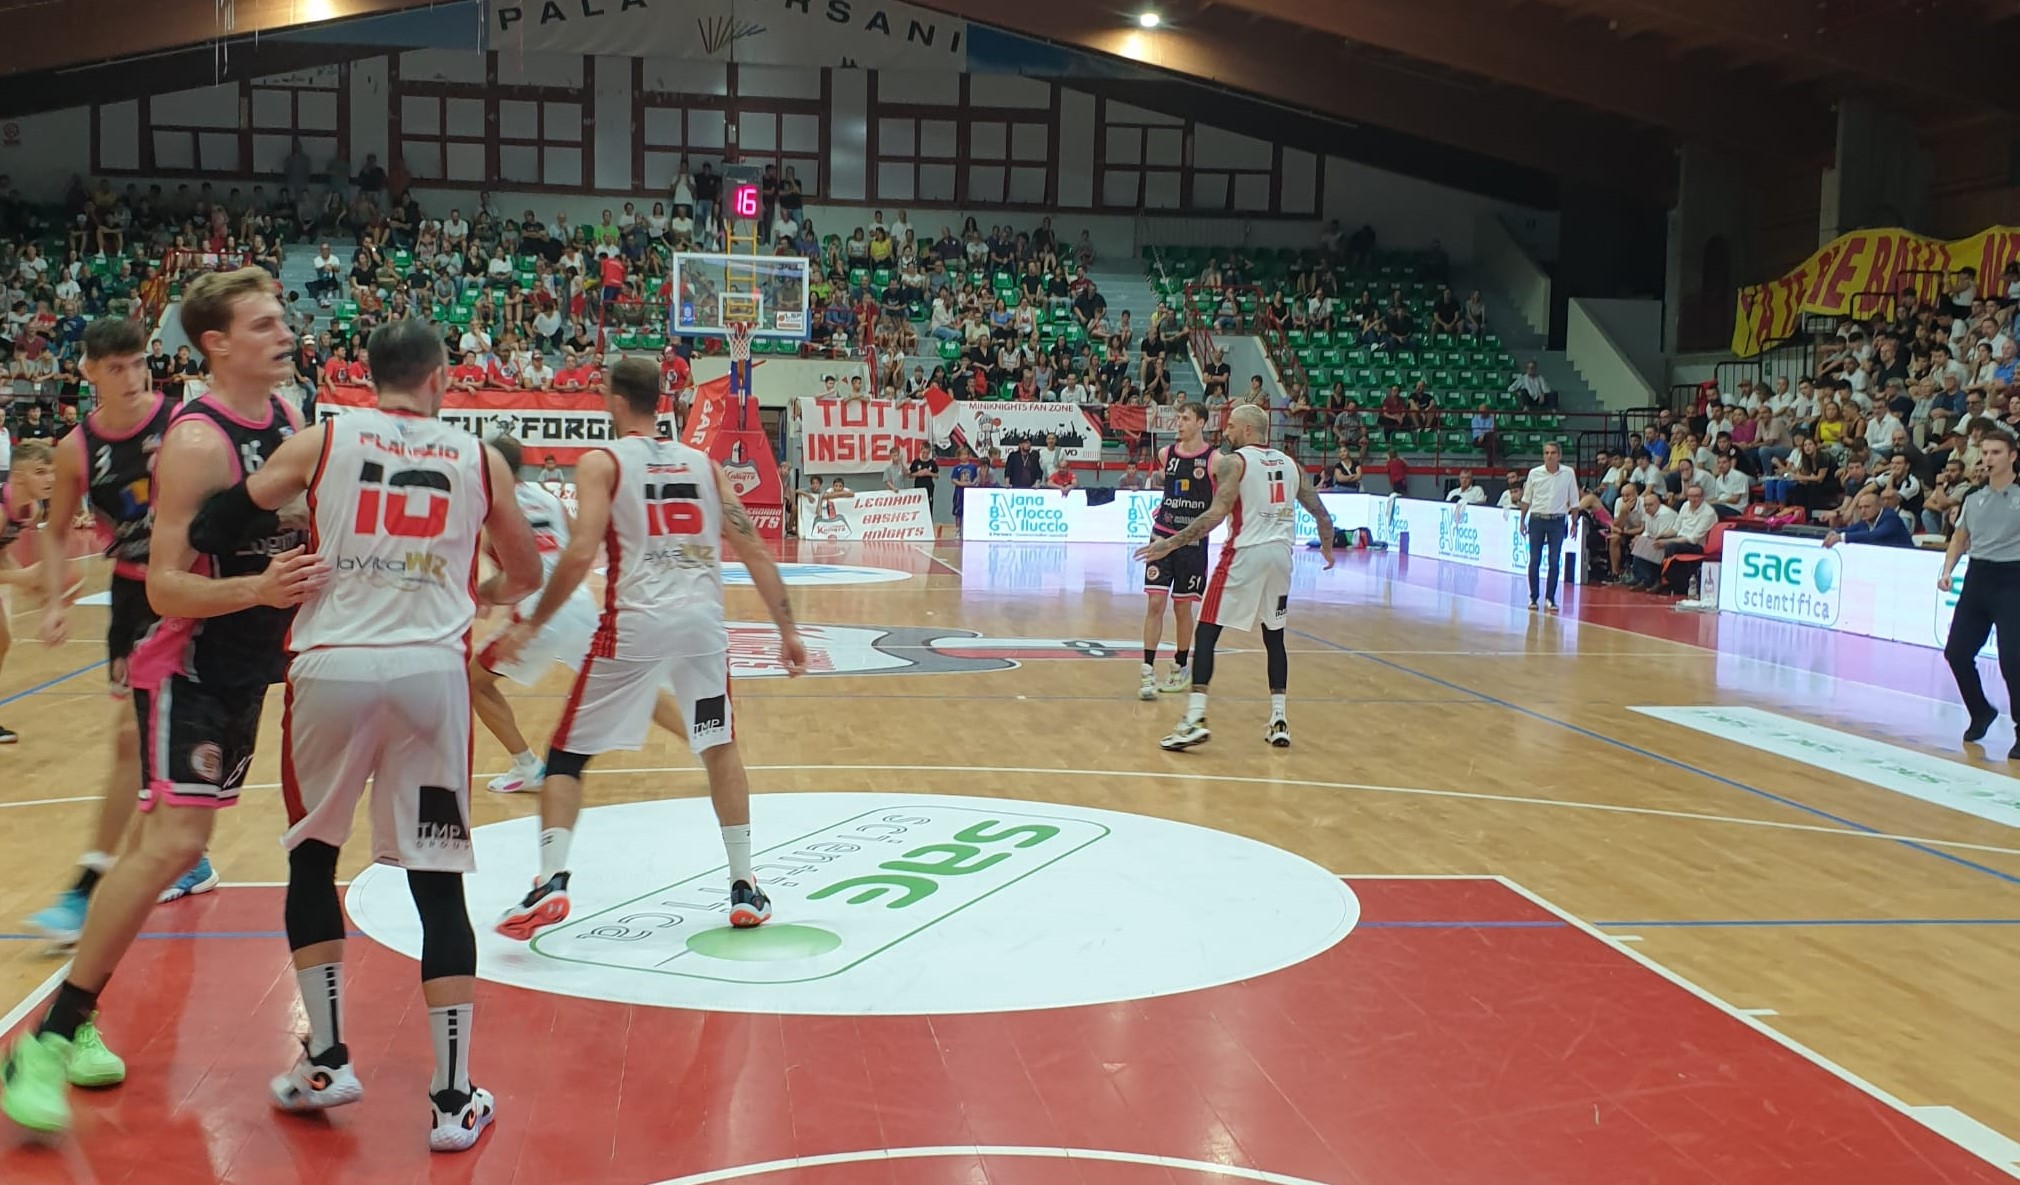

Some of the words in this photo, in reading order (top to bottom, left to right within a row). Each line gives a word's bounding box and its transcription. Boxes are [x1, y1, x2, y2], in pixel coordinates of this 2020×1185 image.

[736, 188, 757, 216] 16
[969, 402, 1027, 411] MINIKNIGHTS
[1030, 403, 1046, 411] FAN
[1049, 404, 1073, 412] ZONE
[1167, 458, 1180, 472] 51
[355, 459, 451, 538] 10
[645, 483, 704, 536] 16
[1187, 575, 1202, 590] 51
[1743, 587, 1829, 620] scientifica
